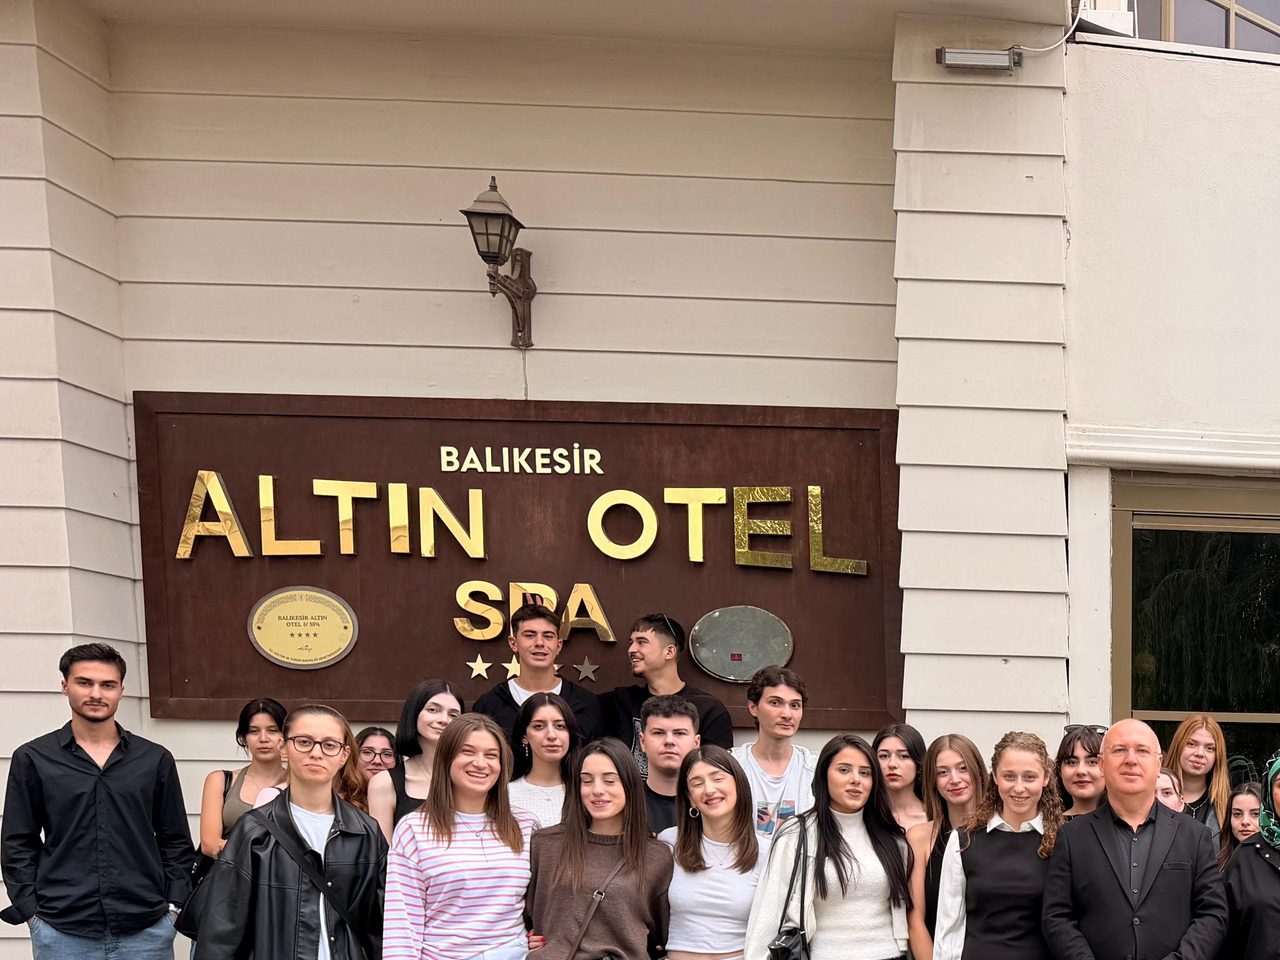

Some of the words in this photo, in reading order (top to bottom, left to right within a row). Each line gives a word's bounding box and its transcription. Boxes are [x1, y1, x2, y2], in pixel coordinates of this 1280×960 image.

[440, 442, 605, 475] BALIKESİR
[175, 469, 487, 560] ALTIN
[587, 485, 868, 576] OTEL
[453, 580, 617, 642] SPA
